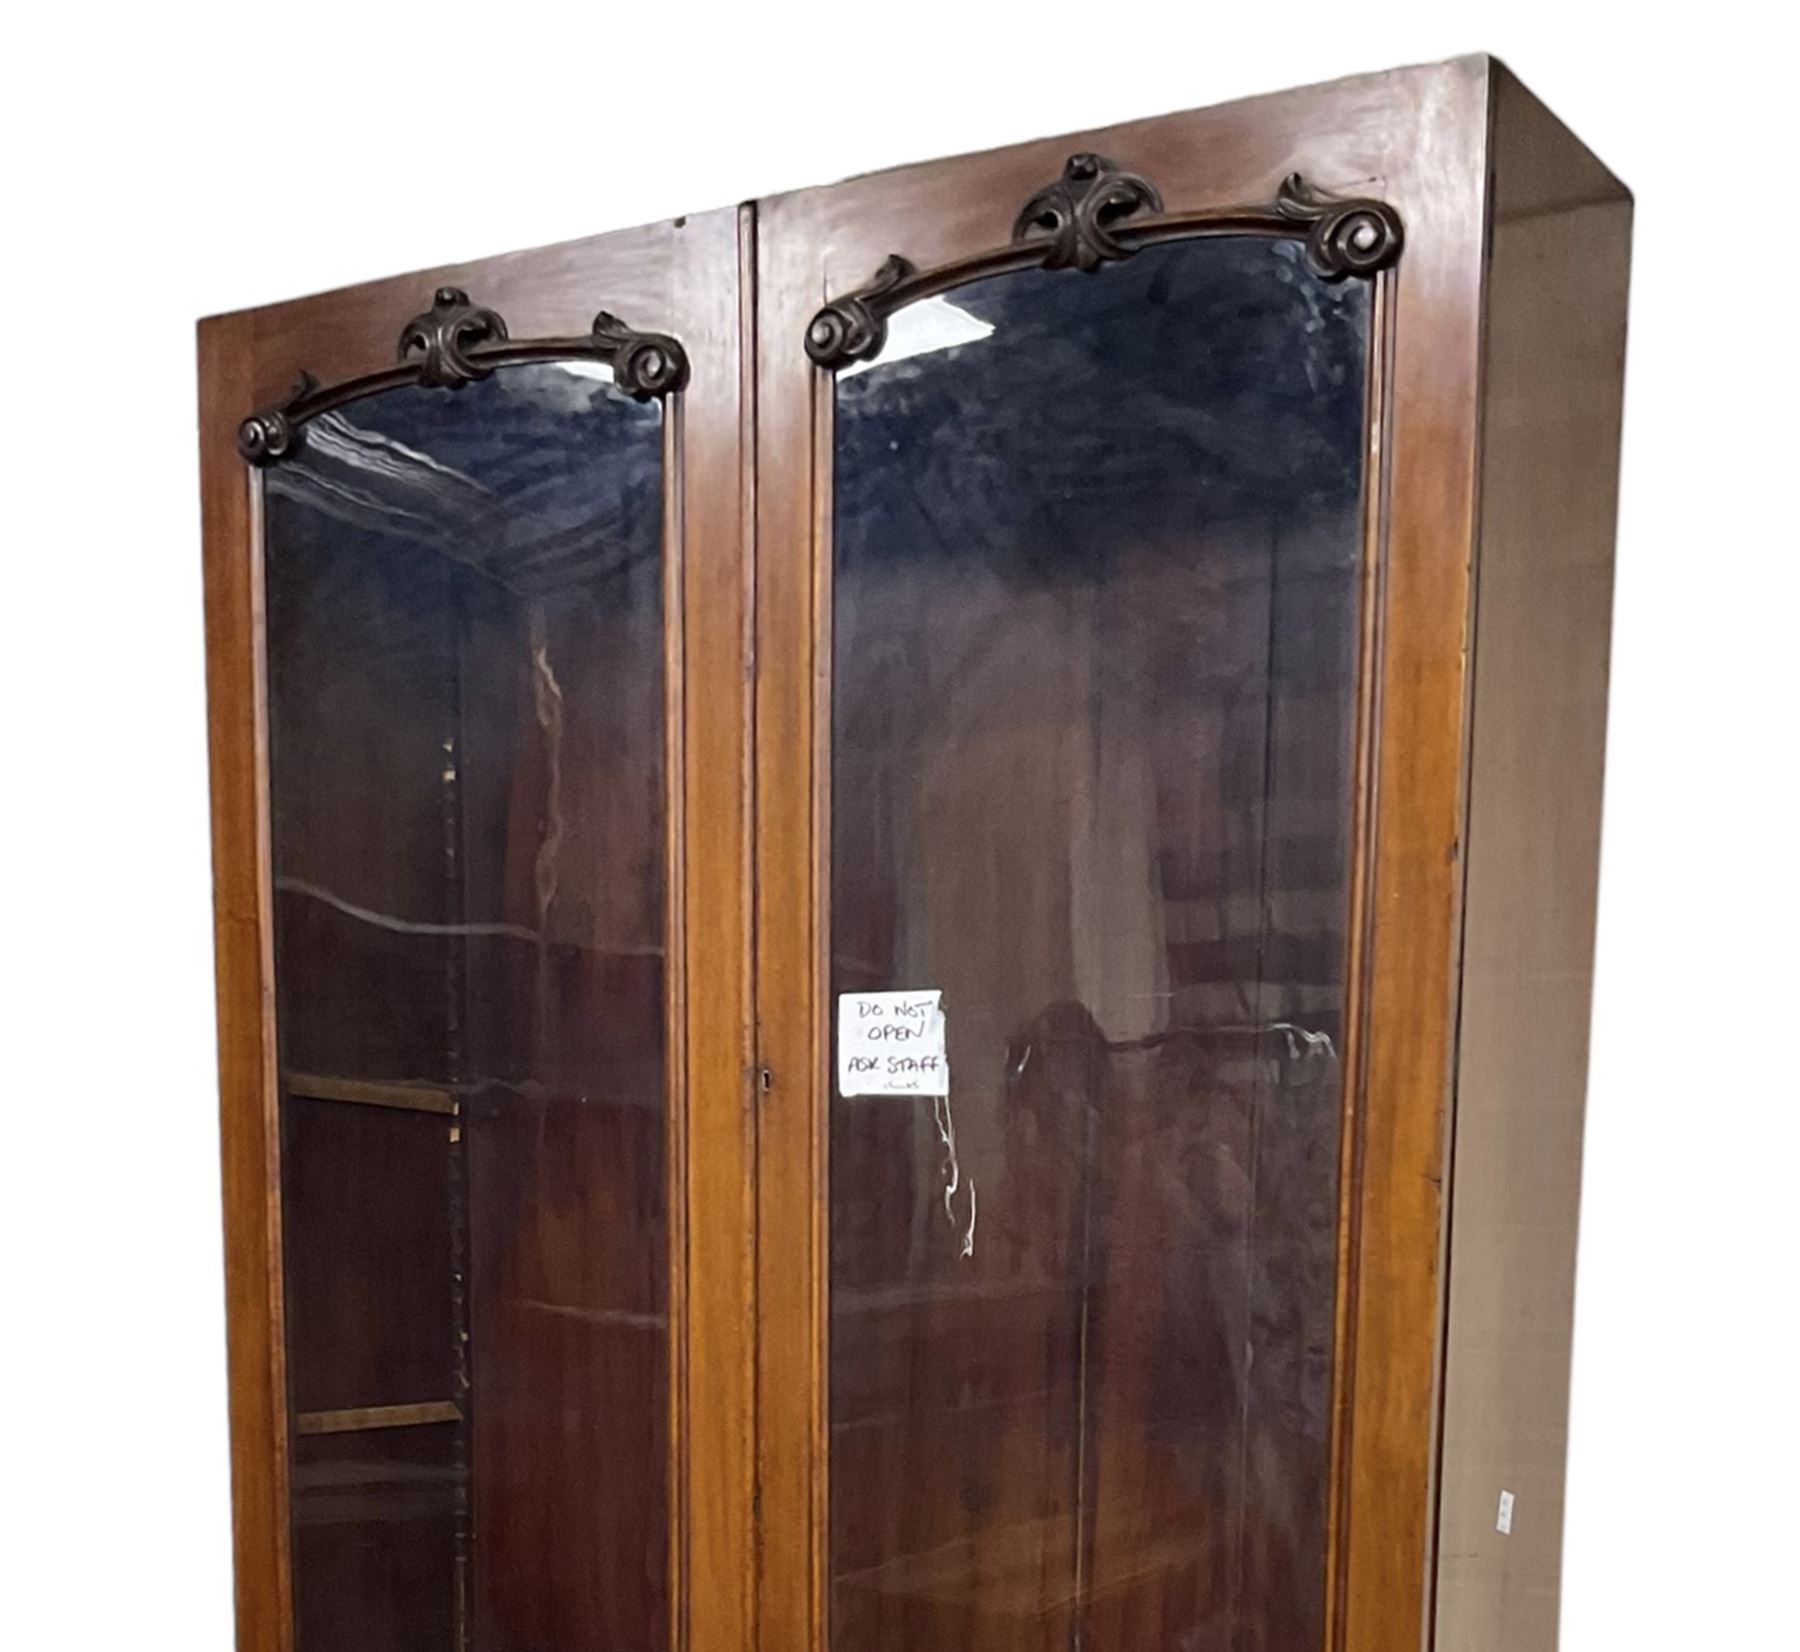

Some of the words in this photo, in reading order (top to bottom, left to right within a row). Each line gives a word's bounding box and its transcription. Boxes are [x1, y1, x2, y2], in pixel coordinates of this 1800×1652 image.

[857, 1001, 883, 1018] DO
[894, 1000, 933, 1018] NOT
[867, 1020, 925, 1041] OPEN
[848, 1056, 880, 1072] ASK
[887, 1056, 940, 1074] STAFF
